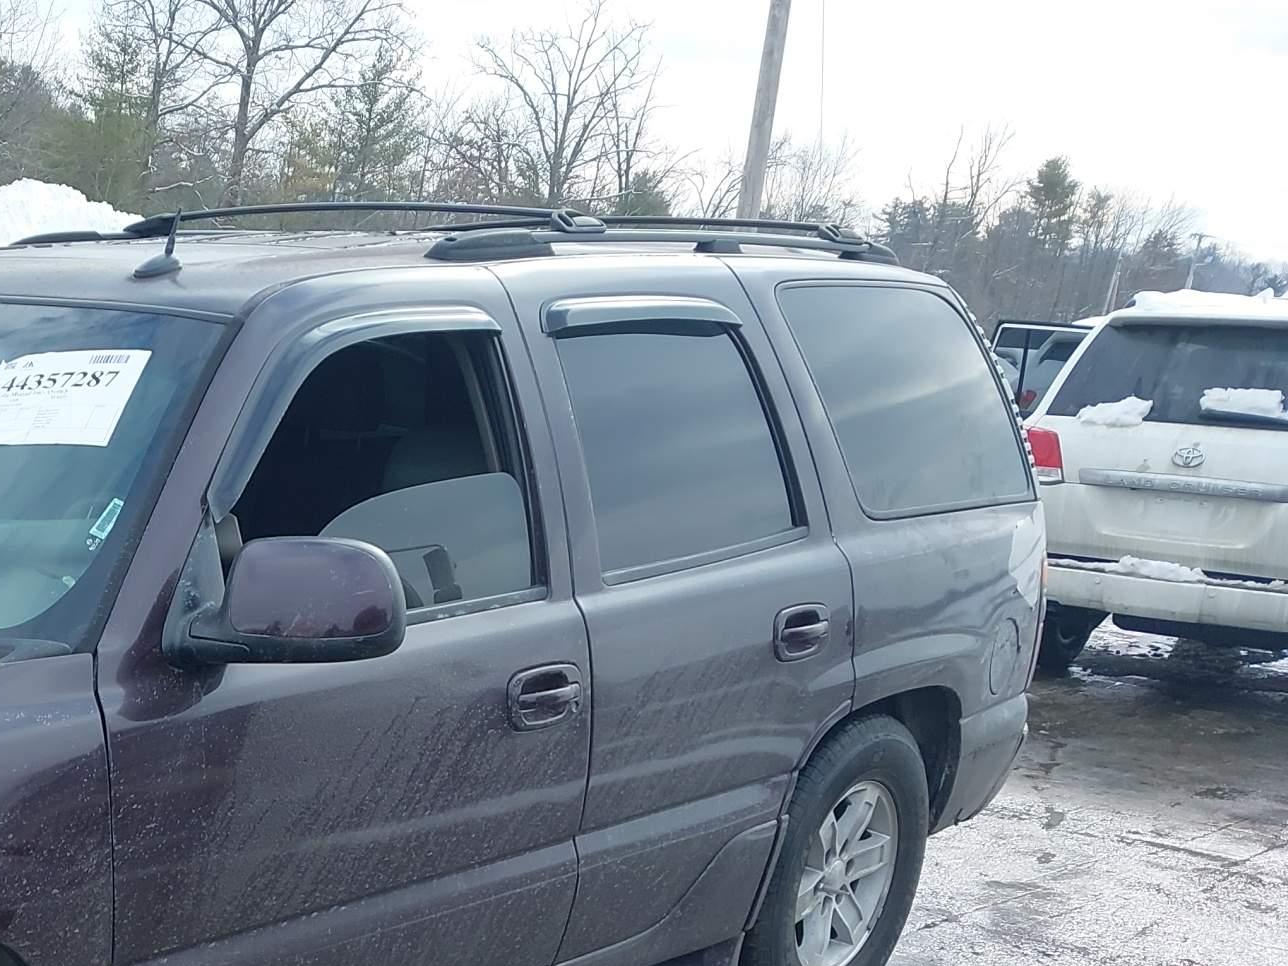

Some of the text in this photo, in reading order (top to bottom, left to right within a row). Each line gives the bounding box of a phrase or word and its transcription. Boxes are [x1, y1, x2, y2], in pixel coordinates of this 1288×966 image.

[1, 370, 120, 392] 44357287
[1106, 475, 1263, 497] LAND CRUISER
